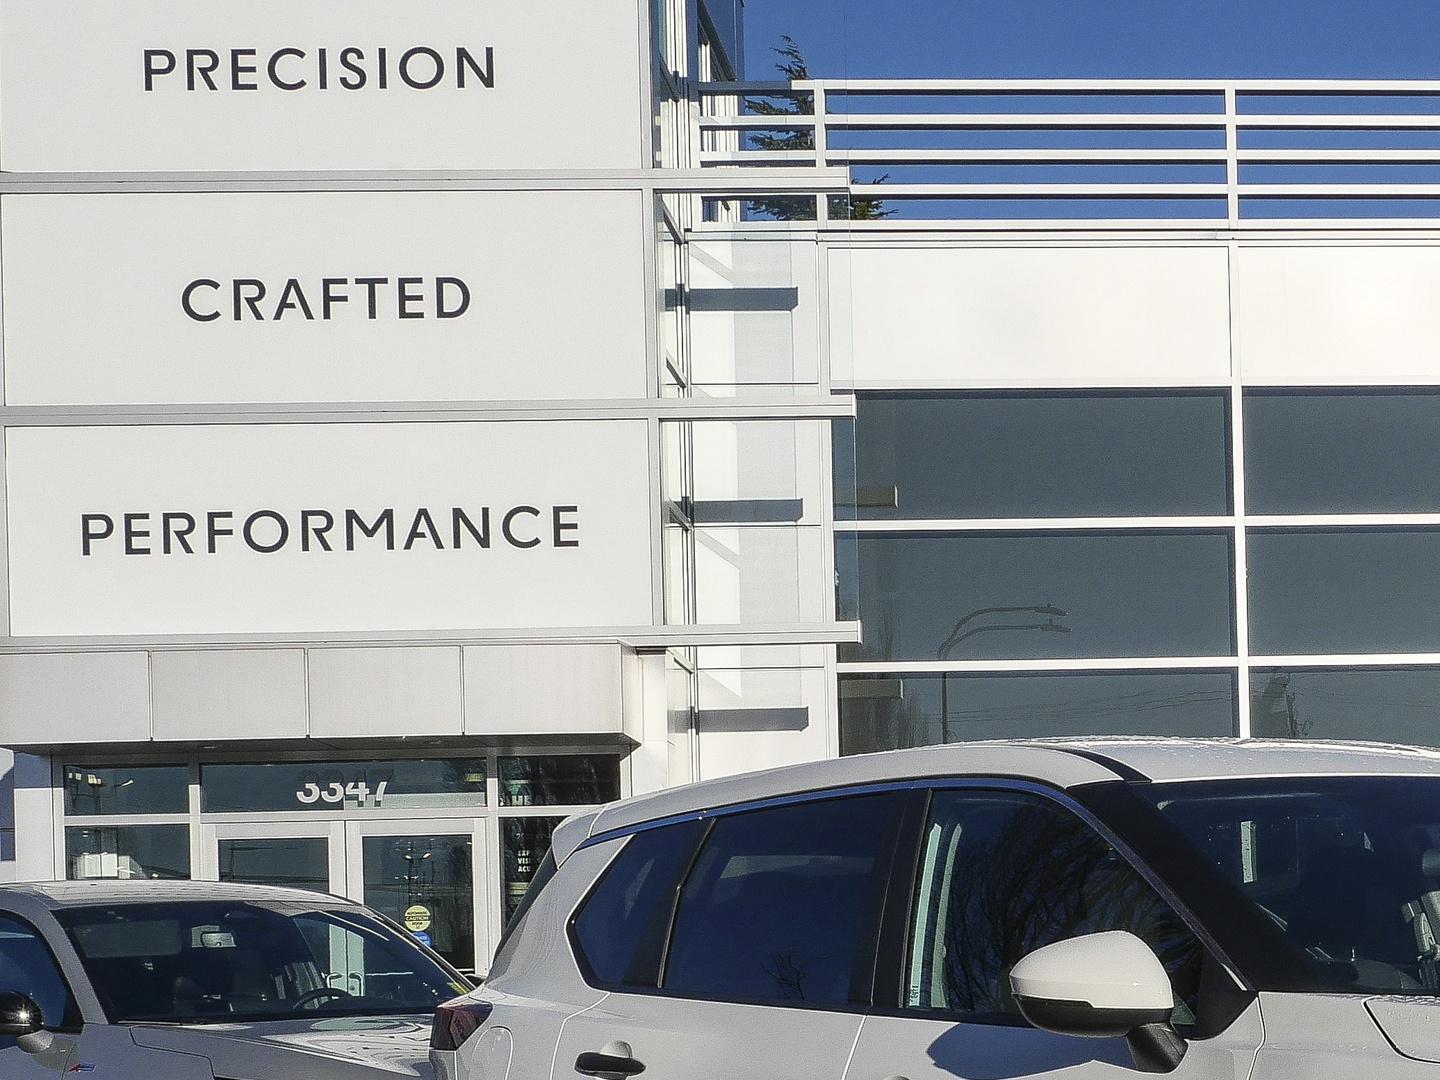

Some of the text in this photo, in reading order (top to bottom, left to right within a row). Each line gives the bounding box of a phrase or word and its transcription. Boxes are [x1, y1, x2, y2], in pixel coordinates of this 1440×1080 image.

[143, 46, 496, 92] PRECISION
[181, 276, 472, 322] CRAFTED
[81, 505, 580, 556] PERFORMANCE
[296, 768, 394, 804] 3347
